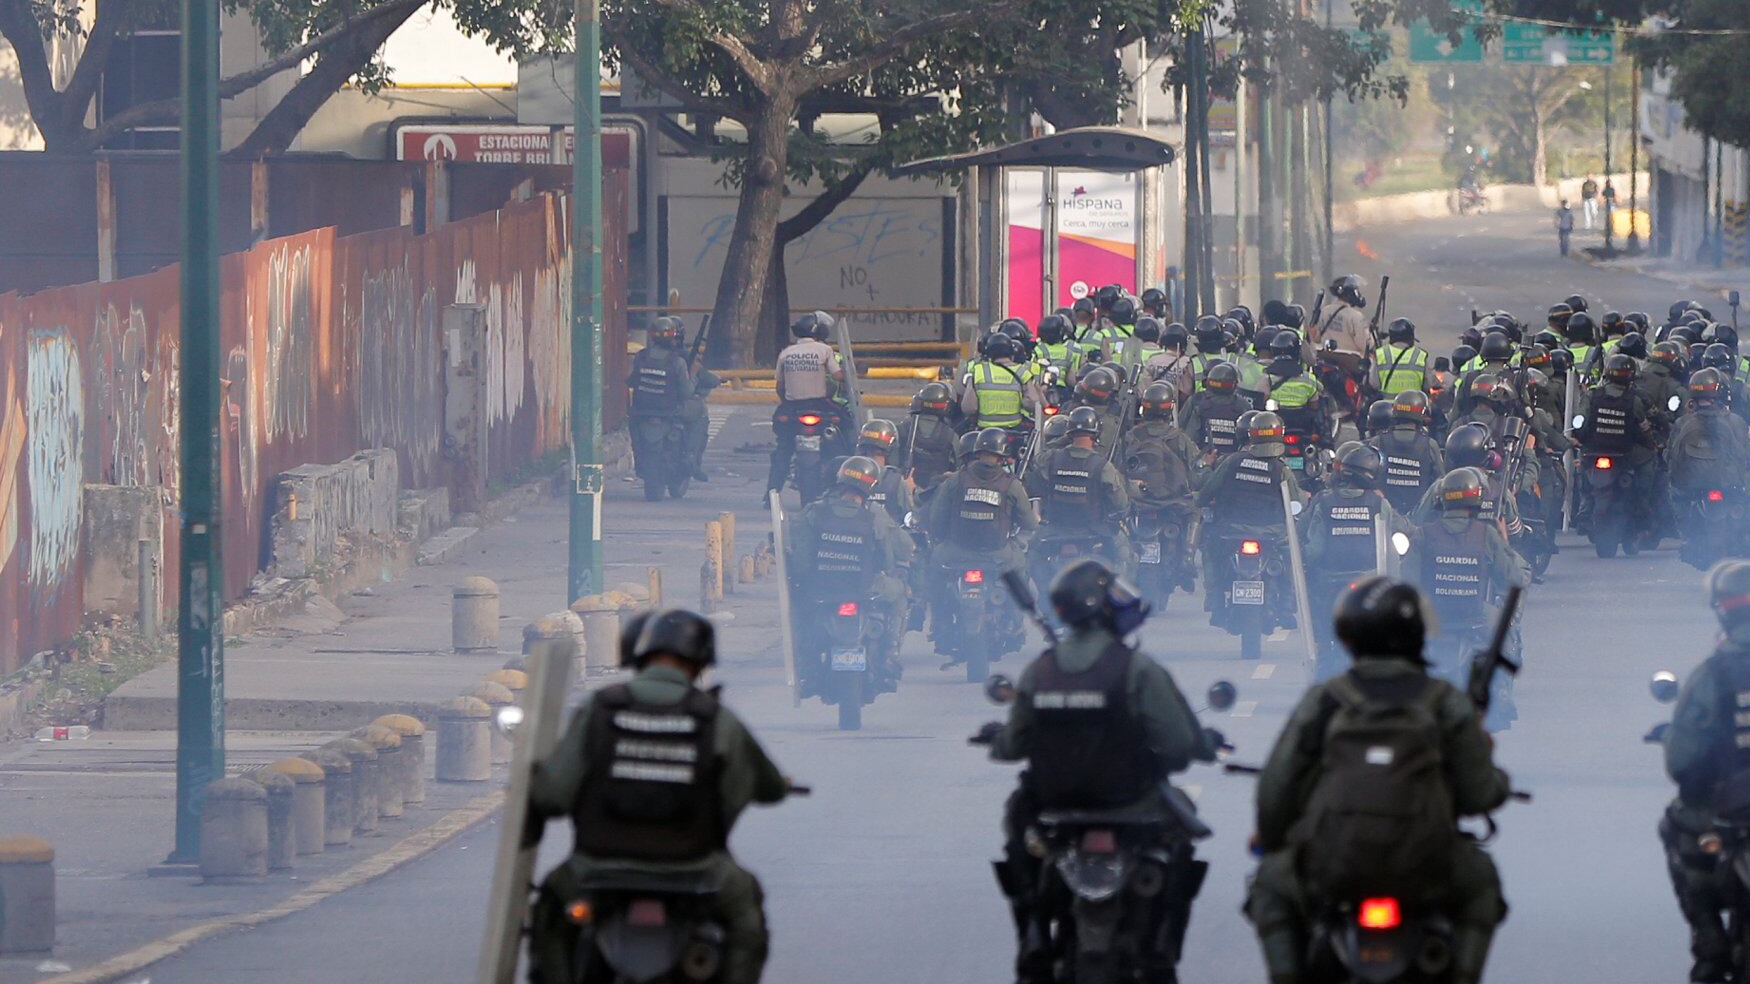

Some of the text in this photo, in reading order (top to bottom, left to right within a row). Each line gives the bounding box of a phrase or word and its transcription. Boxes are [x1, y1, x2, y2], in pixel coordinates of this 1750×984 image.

[840, 266, 867, 289] NO
[821, 532, 863, 545] GUARDIA
[1435, 556, 1478, 565] GUARDIA
[1435, 573, 1479, 583] NACIONAL
